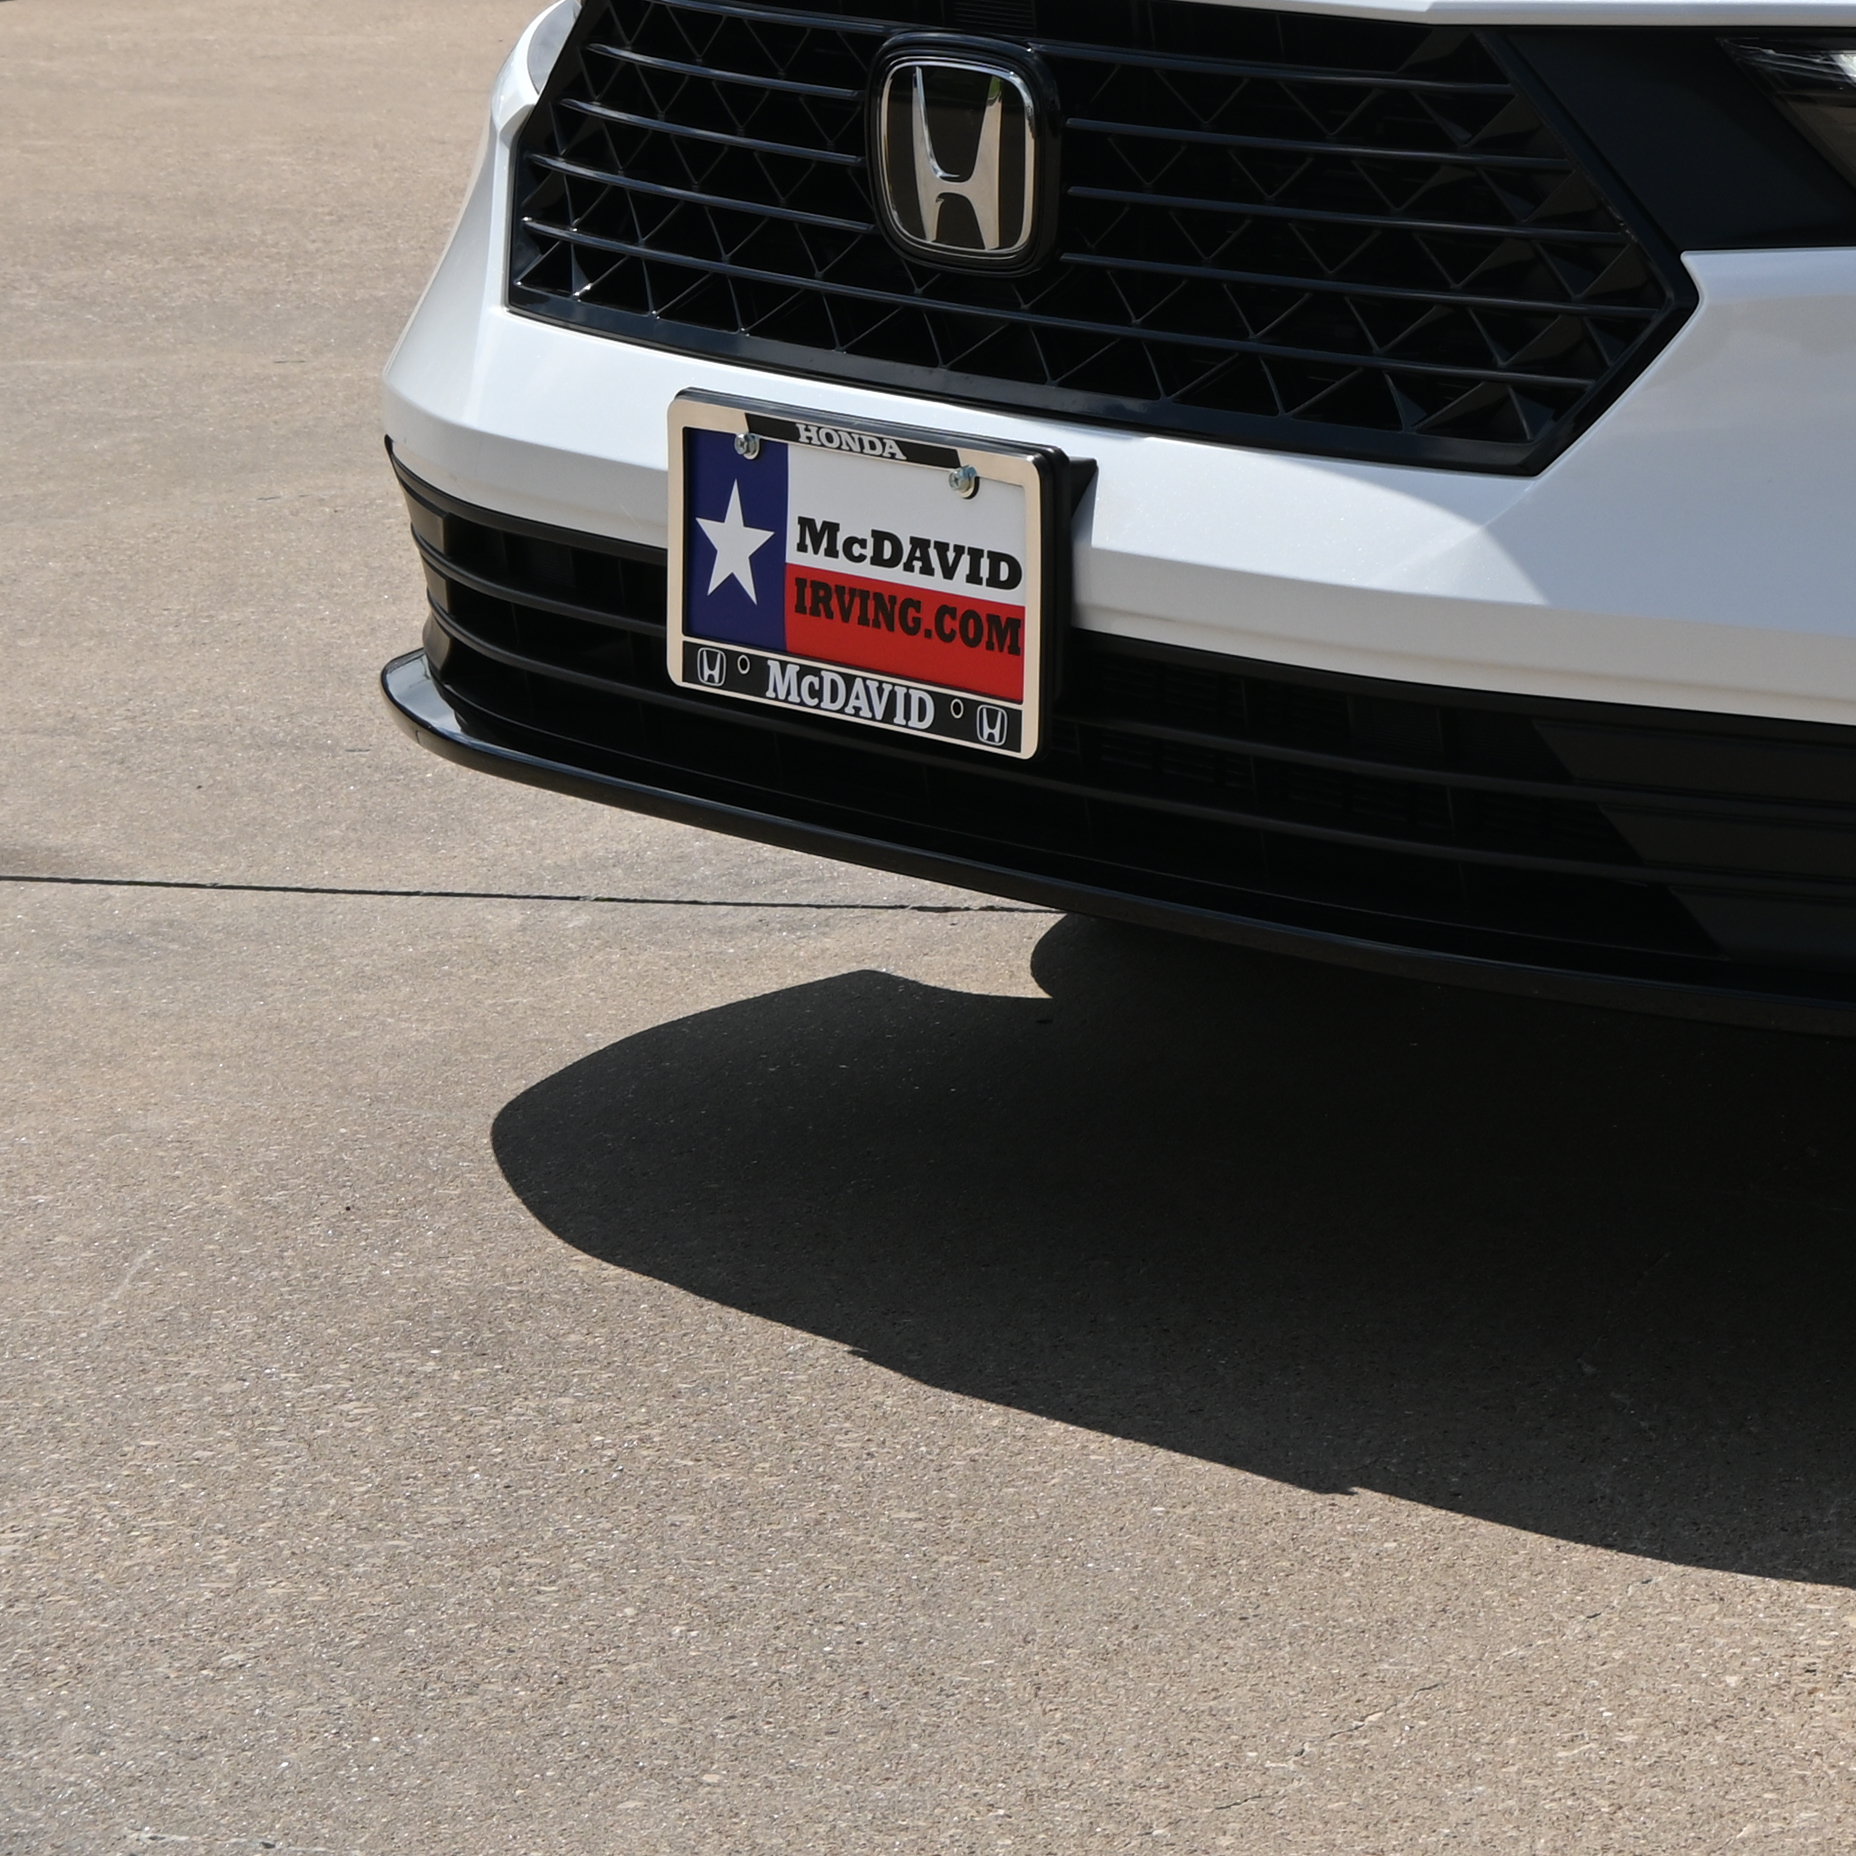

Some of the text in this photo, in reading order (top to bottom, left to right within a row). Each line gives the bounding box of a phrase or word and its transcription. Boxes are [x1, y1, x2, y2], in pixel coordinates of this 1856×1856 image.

[795, 423, 907, 461] HONDA
[795, 516, 1023, 592] McDAVID
[794, 577, 1022, 656] IRVING.COM
[765, 659, 935, 730] McDAVID
